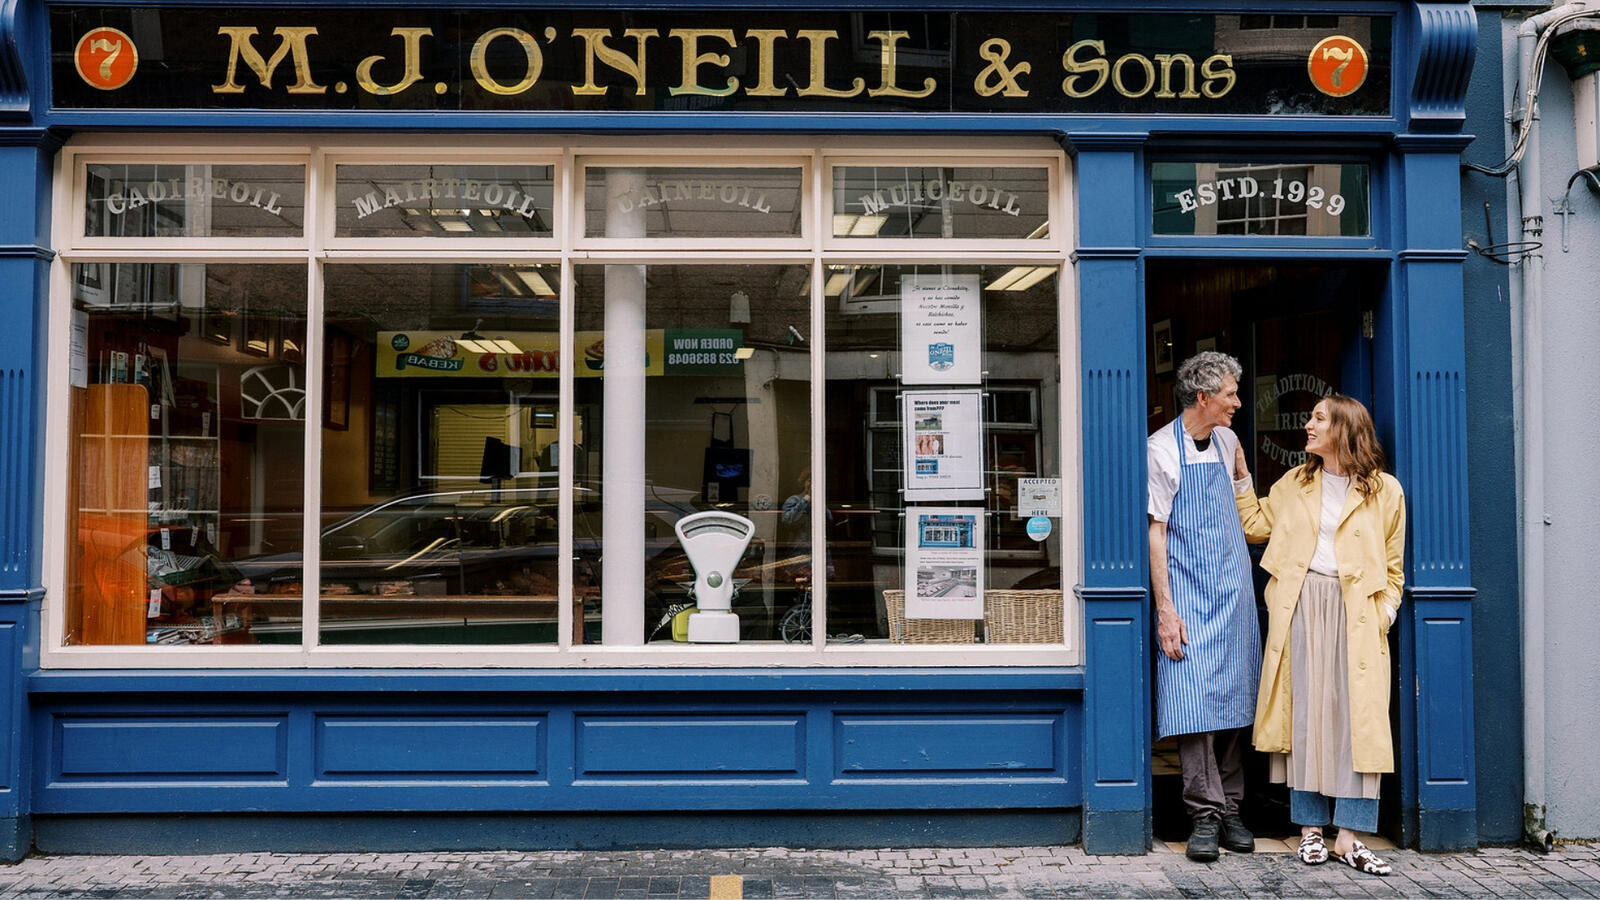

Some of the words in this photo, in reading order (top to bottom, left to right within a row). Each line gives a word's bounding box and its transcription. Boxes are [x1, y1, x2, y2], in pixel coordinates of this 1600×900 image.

[90, 38, 122, 80] 7
[973, 38, 1032, 97] &
[1062, 39, 1237, 99] Sons
[1321, 46, 1354, 89] 7
[106, 176, 283, 217] CAOIREOIL
[351, 176, 536, 219] MAIRTEOIL
[857, 180, 1021, 217] MUICEOIL
[1174, 176, 1265, 214] ESTD.
[1272, 178, 1346, 217] 1929
[1256, 373, 1340, 414] TRADITIONA
[1274, 411, 1313, 431] IRIS
[1261, 435, 1307, 468] BUTCH
